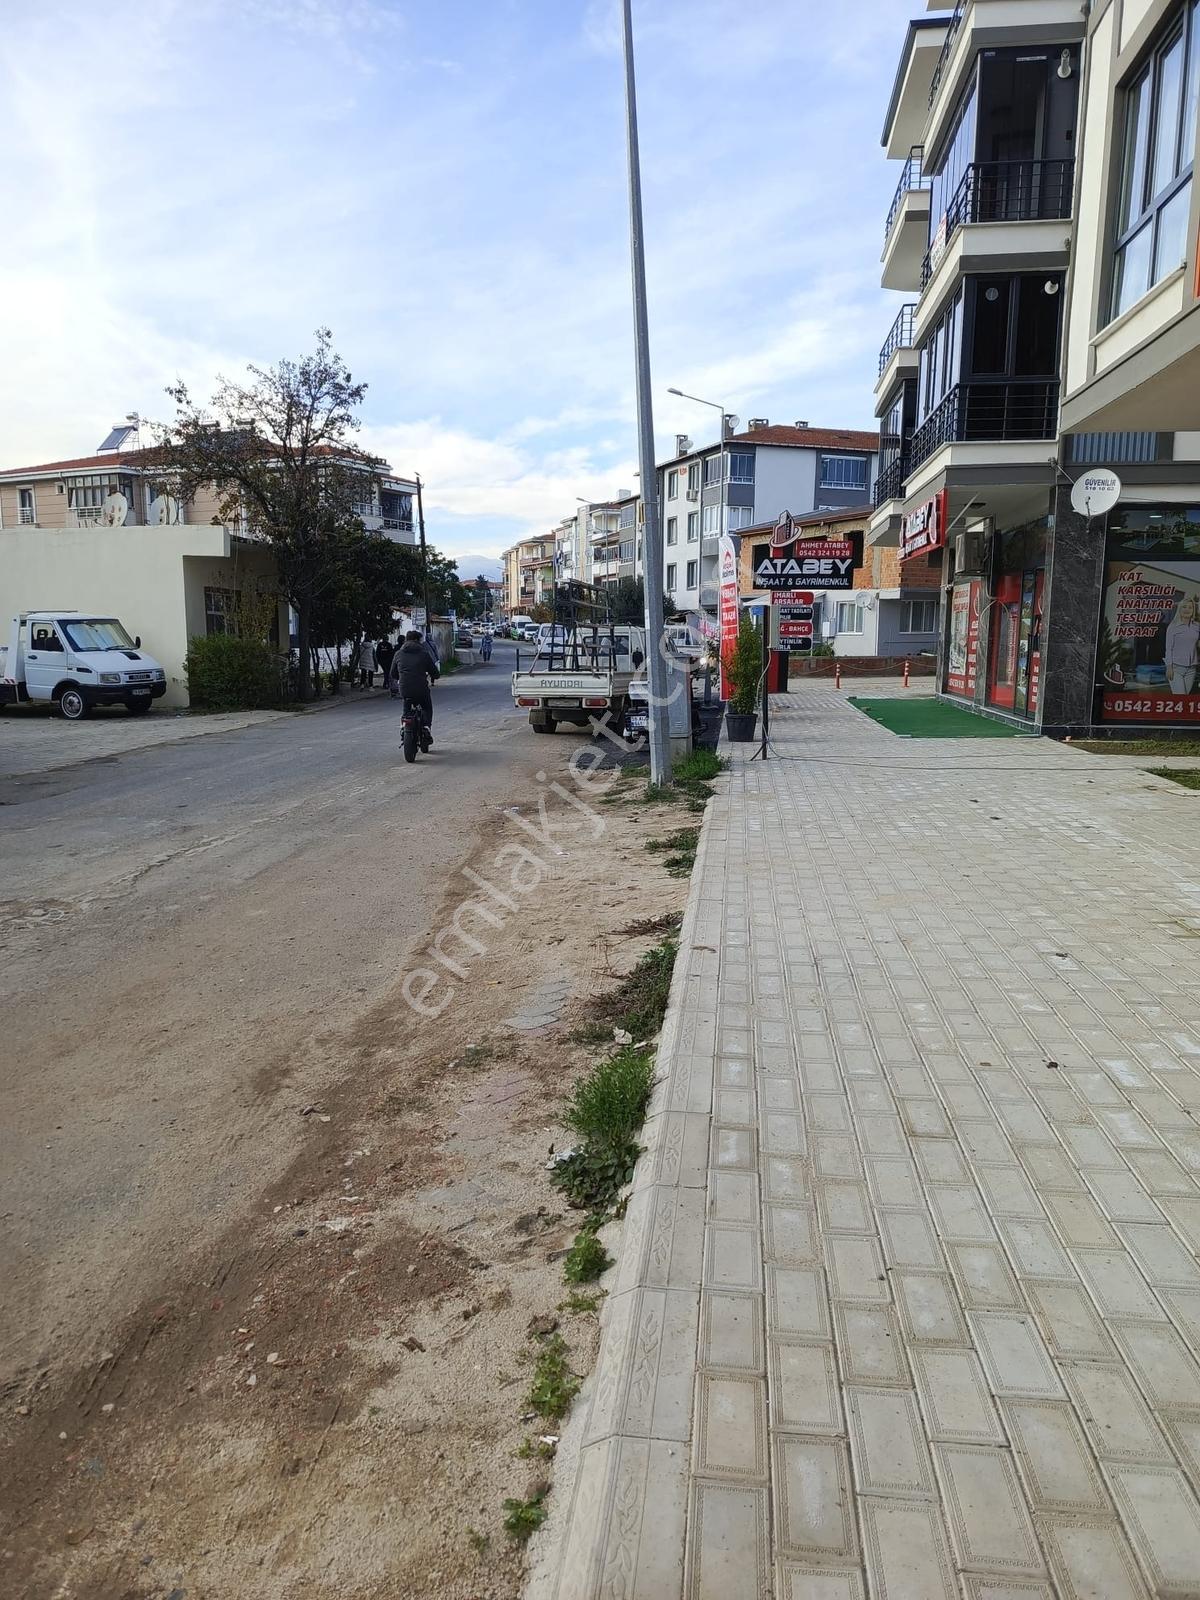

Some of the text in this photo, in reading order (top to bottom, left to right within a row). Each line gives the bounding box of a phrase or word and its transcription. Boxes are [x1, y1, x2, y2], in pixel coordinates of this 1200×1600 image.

[756, 558, 853, 574] ATABEY
[755, 576, 850, 588] İNŞAAT & GAYRİMENKUL
[1117, 572, 1143, 582] KAT
[1117, 583, 1176, 596] KARŞILIĞI
[1116, 598, 1173, 609] ANAHTAR
[1115, 611, 1162, 624] TESLİMİ
[788, 625, 809, 633] BAHÇE
[1114, 622, 1159, 637] İNŞAAT
[1114, 701, 1151, 712] 0542
[1155, 701, 1184, 713] 324
